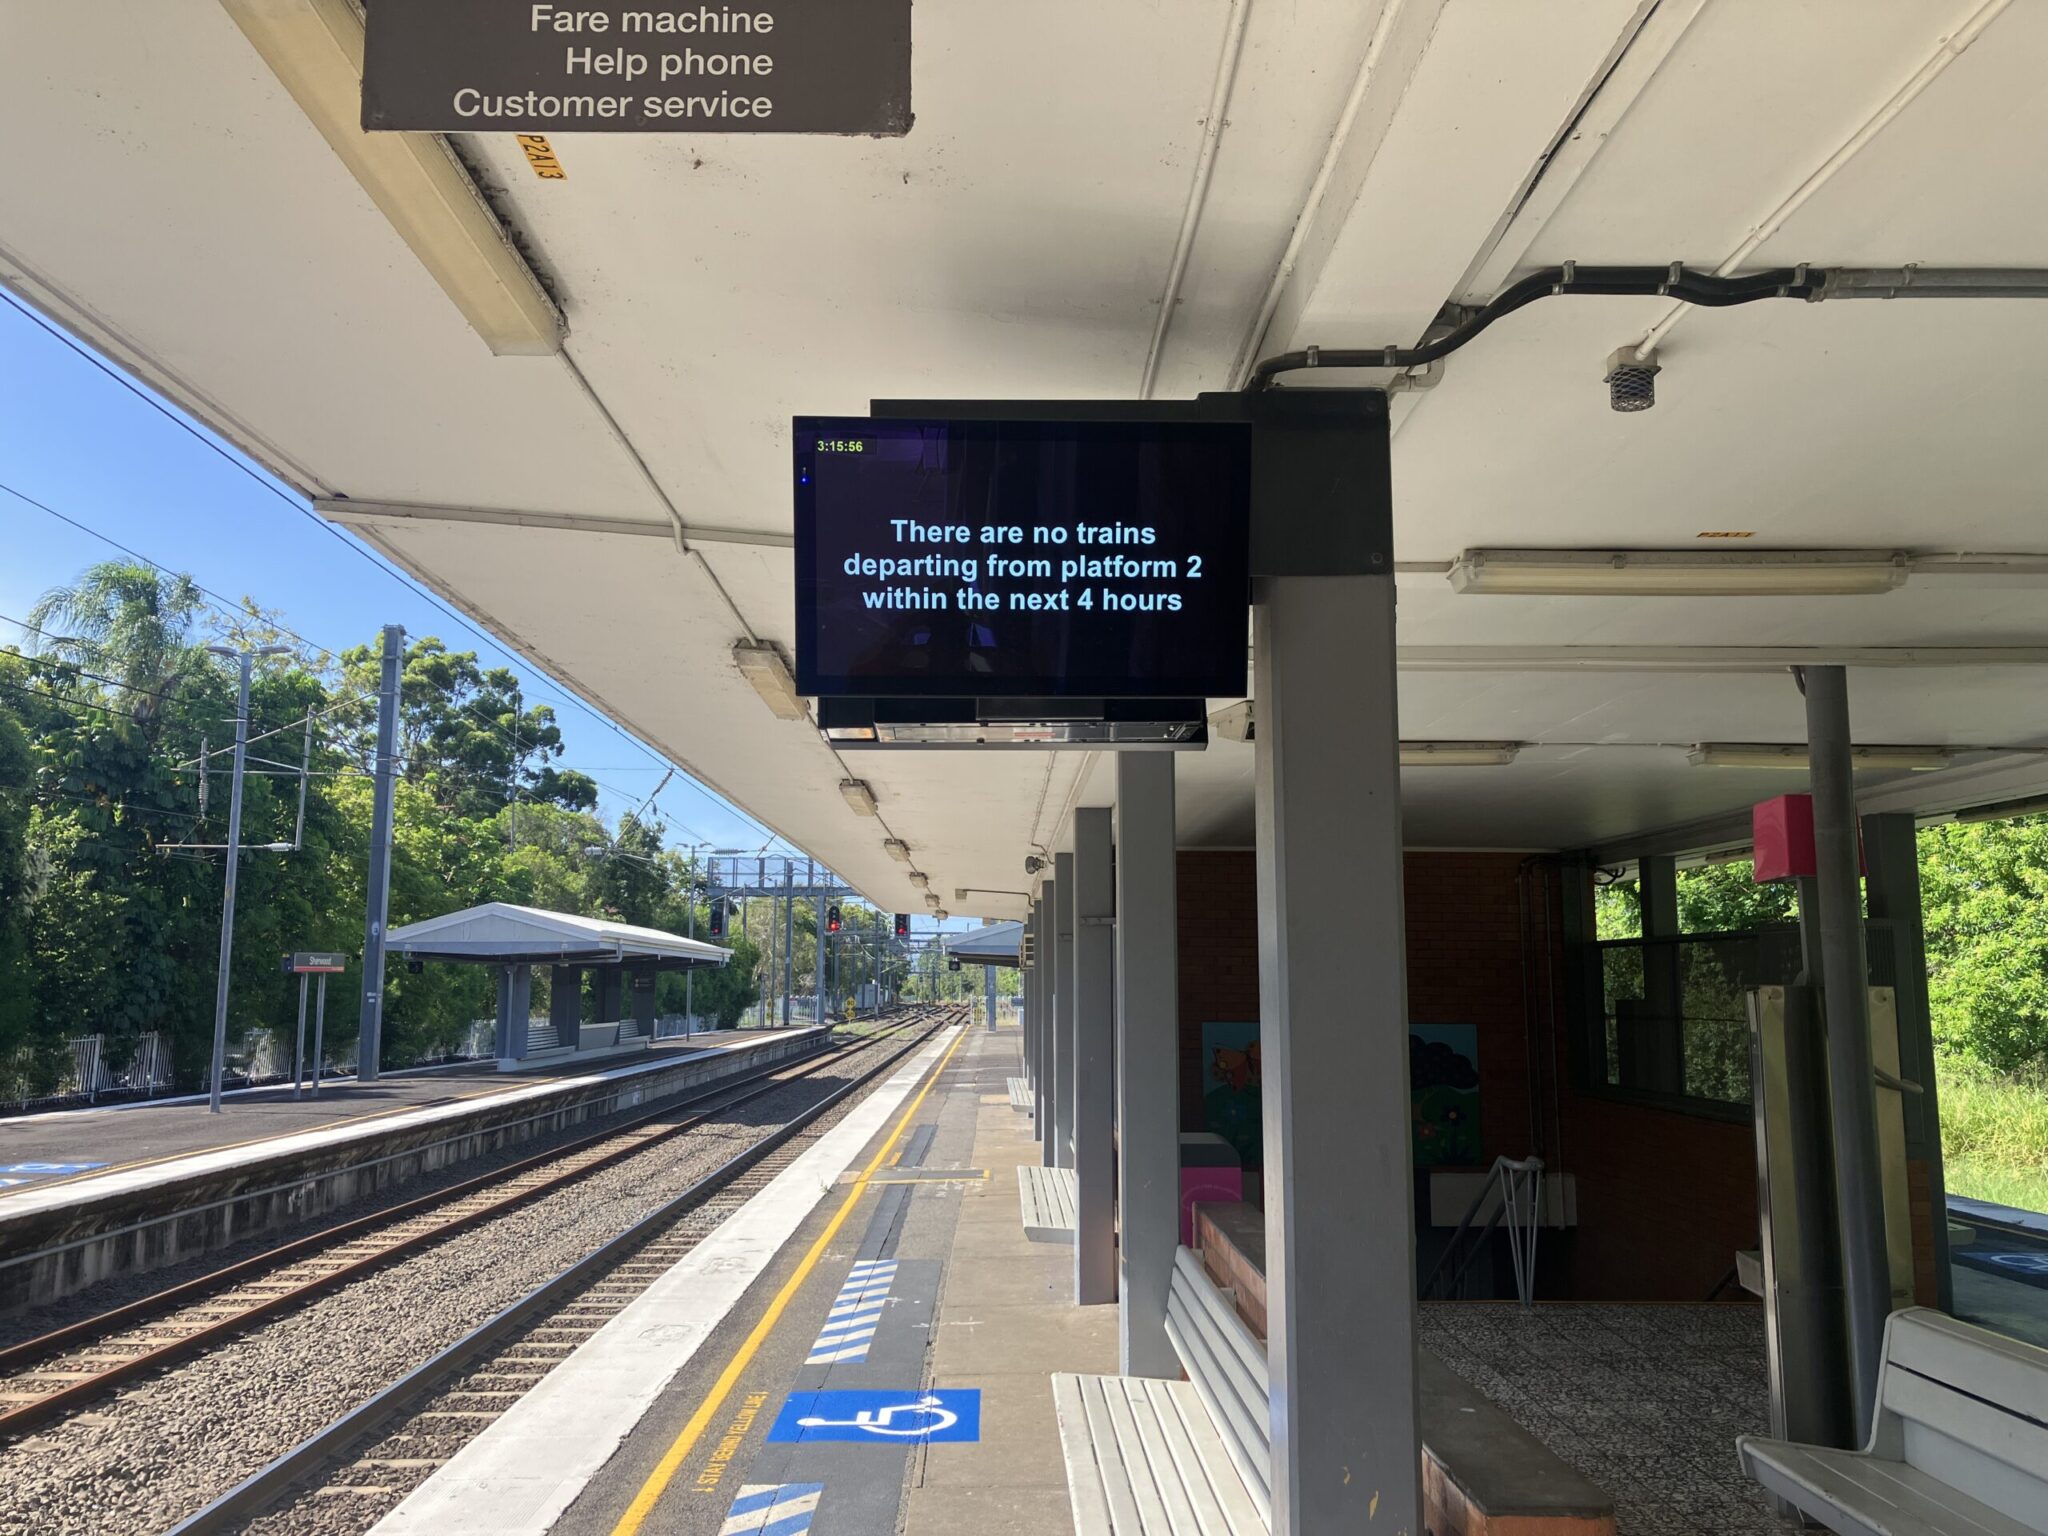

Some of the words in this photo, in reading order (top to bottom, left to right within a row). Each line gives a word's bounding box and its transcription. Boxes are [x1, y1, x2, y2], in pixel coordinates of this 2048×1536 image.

[531, 4, 610, 33] Fare
[622, 4, 774, 34] machine
[566, 46, 648, 82] Help
[660, 47, 773, 82] phone
[453, 88, 634, 118] Customer
[643, 90, 773, 118] service
[517, 134, 564, 179] P2A13
[817, 440, 863, 453] 3:15:56
[890, 519, 971, 544] There
[979, 525, 1024, 544] are
[1033, 526, 1068, 544] no
[1076, 521, 1156, 545] trains
[843, 552, 978, 582] departing
[986, 553, 1051, 578] from
[1061, 554, 1177, 583] platform
[1186, 555, 1202, 578] 2
[862, 586, 947, 610] within
[956, 587, 1000, 610] the
[1010, 588, 1070, 611] next
[1077, 588, 1094, 611] 4
[1103, 587, 1183, 611] hours
[697, 1463, 727, 1485] STAY
